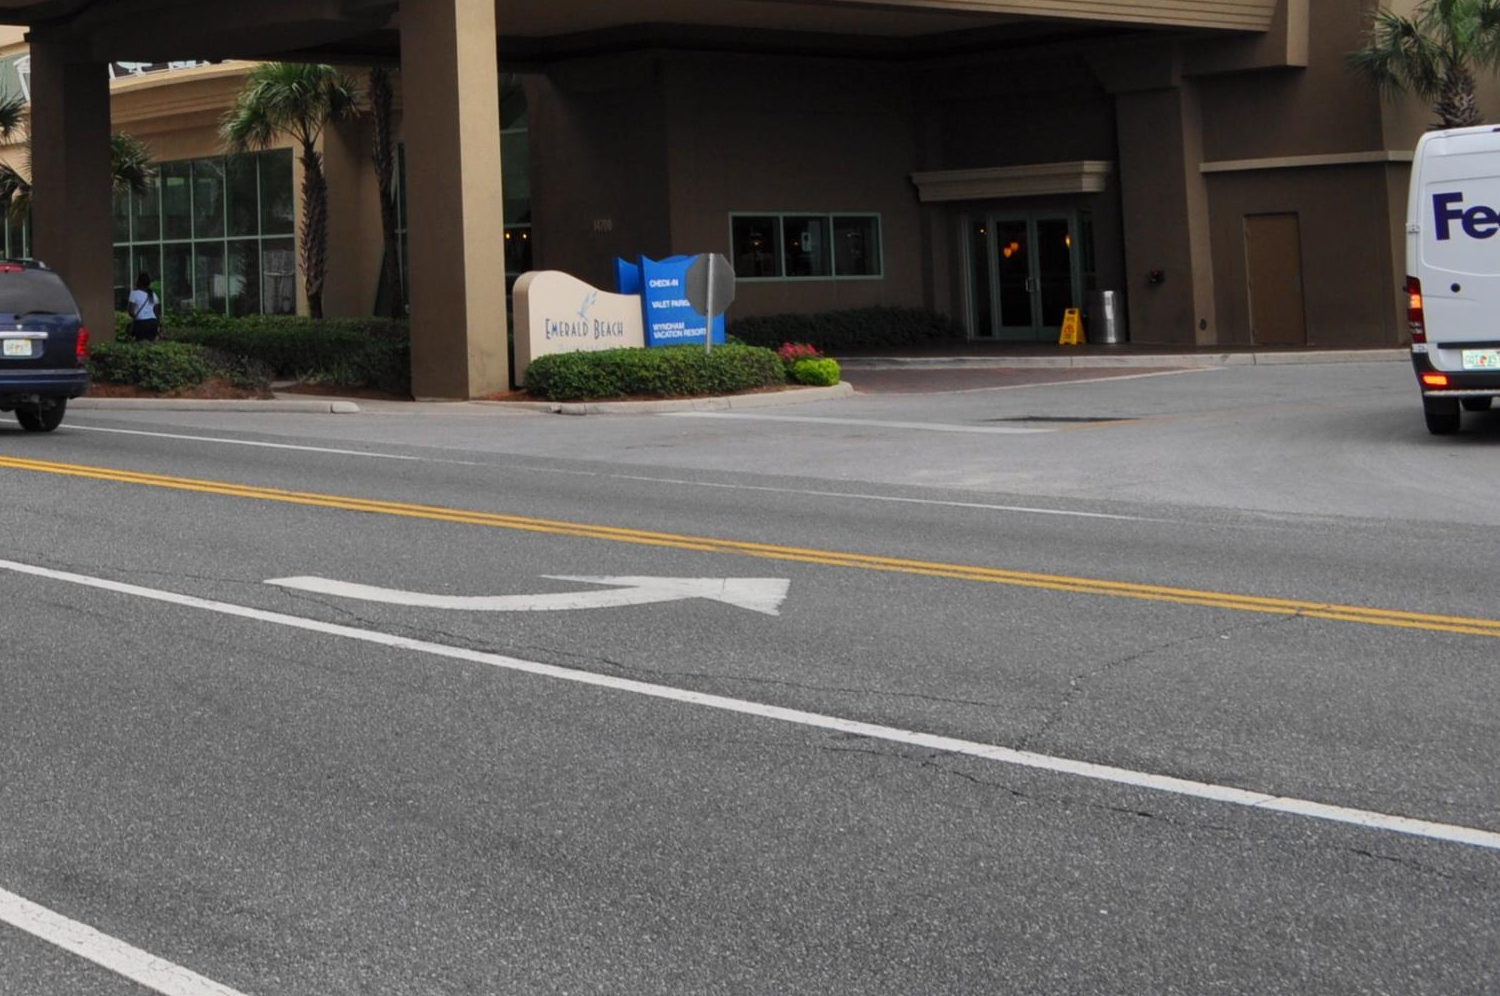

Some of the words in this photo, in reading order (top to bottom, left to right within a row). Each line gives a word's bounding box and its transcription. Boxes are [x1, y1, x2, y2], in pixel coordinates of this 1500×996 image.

[1432, 191, 1500, 240] Fe
[649, 279, 679, 288] CHECK-IN
[651, 300, 670, 309] VALET
[545, 318, 588, 340] EMERALD
[594, 318, 624, 340] BEACH
[652, 322, 685, 331] WYNDHAM
[653, 330, 683, 339] VACATION
